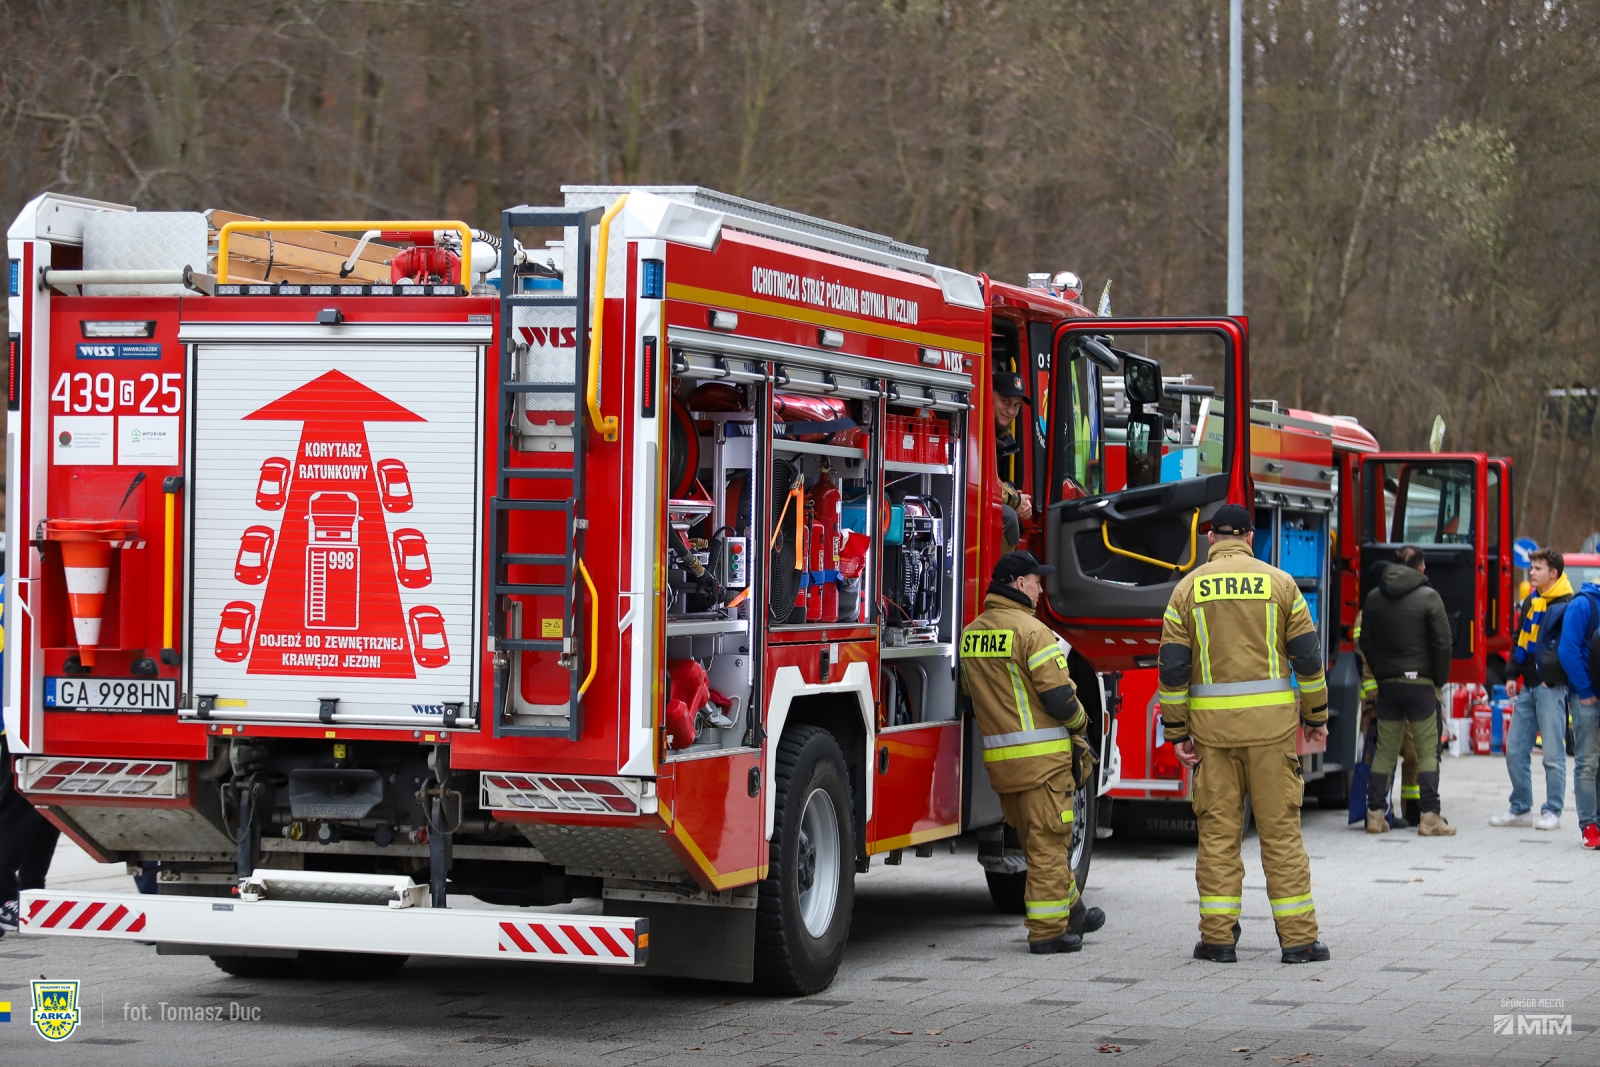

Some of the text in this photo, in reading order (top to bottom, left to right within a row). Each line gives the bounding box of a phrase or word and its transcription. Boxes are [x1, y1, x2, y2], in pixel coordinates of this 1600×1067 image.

[752, 266, 918, 326] OCHOTNICZA STRAŻ POŻARNA GDYNIA WICZLINO
[518, 327, 592, 348] WIS
[80, 346, 115, 356] WISS
[943, 351, 964, 373] WISS
[51, 372, 182, 413] 439 G 25
[305, 442, 362, 458] KORYTARZ
[299, 464, 368, 480] RATUNKOWY
[328, 551, 354, 570] 998
[1200, 577, 1264, 597] STRAŻ
[260, 632, 404, 652] DOJEDŹ DO ZEWNĘTRZNEJ
[963, 634, 1007, 653] STRAŻ
[282, 653, 381, 669] KRAWĘDZI JEZDNI
[61, 681, 170, 707] GA 998HN
[411, 704, 443, 715] WISS
